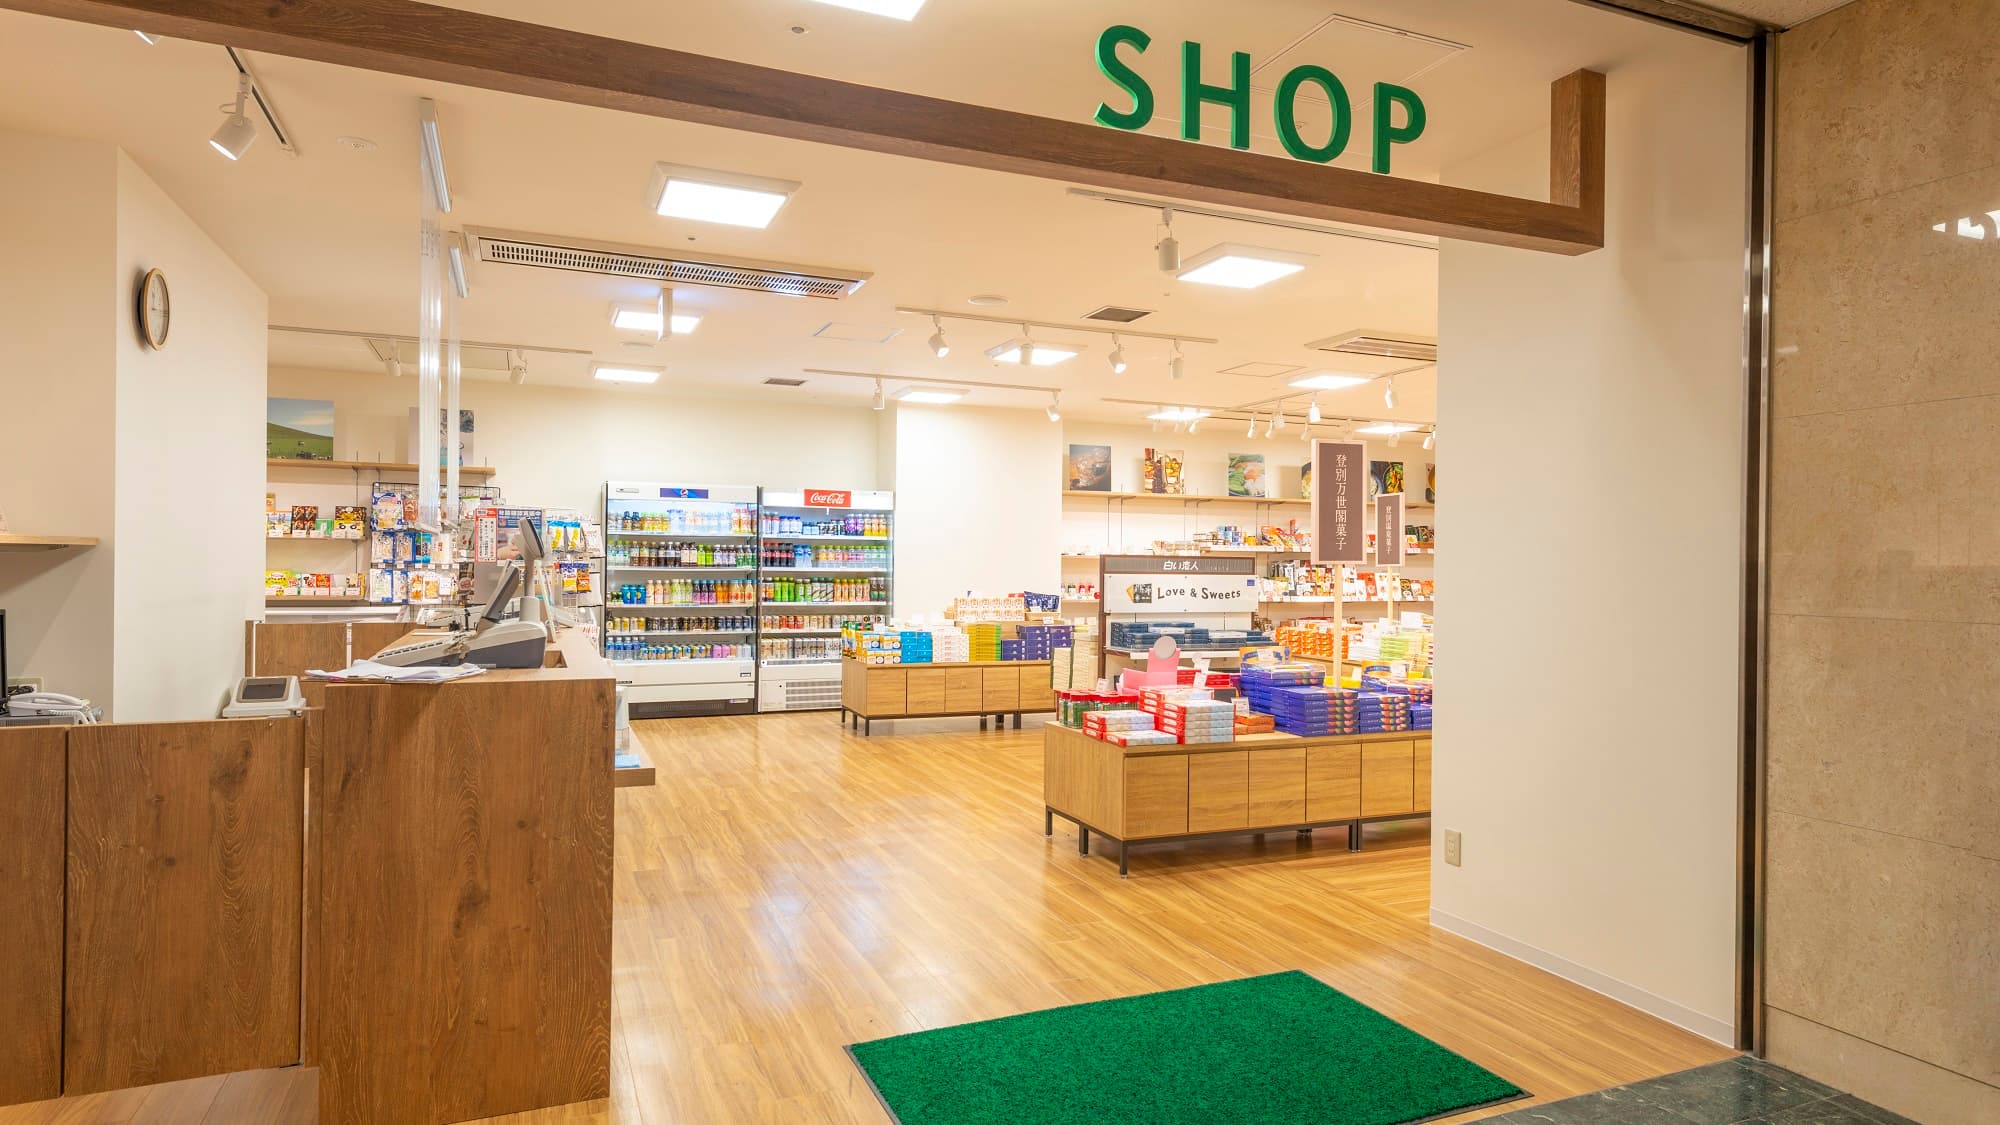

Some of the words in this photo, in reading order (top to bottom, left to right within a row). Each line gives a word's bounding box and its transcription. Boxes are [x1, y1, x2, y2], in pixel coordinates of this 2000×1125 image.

[1094, 24, 1426, 175] SHOP
[1335, 454, 1347, 551] 登別万世閣菓子
[1157, 587, 1185, 599] Love
[1190, 588, 1197, 598] &
[1201, 587, 1241, 600] Sweets
